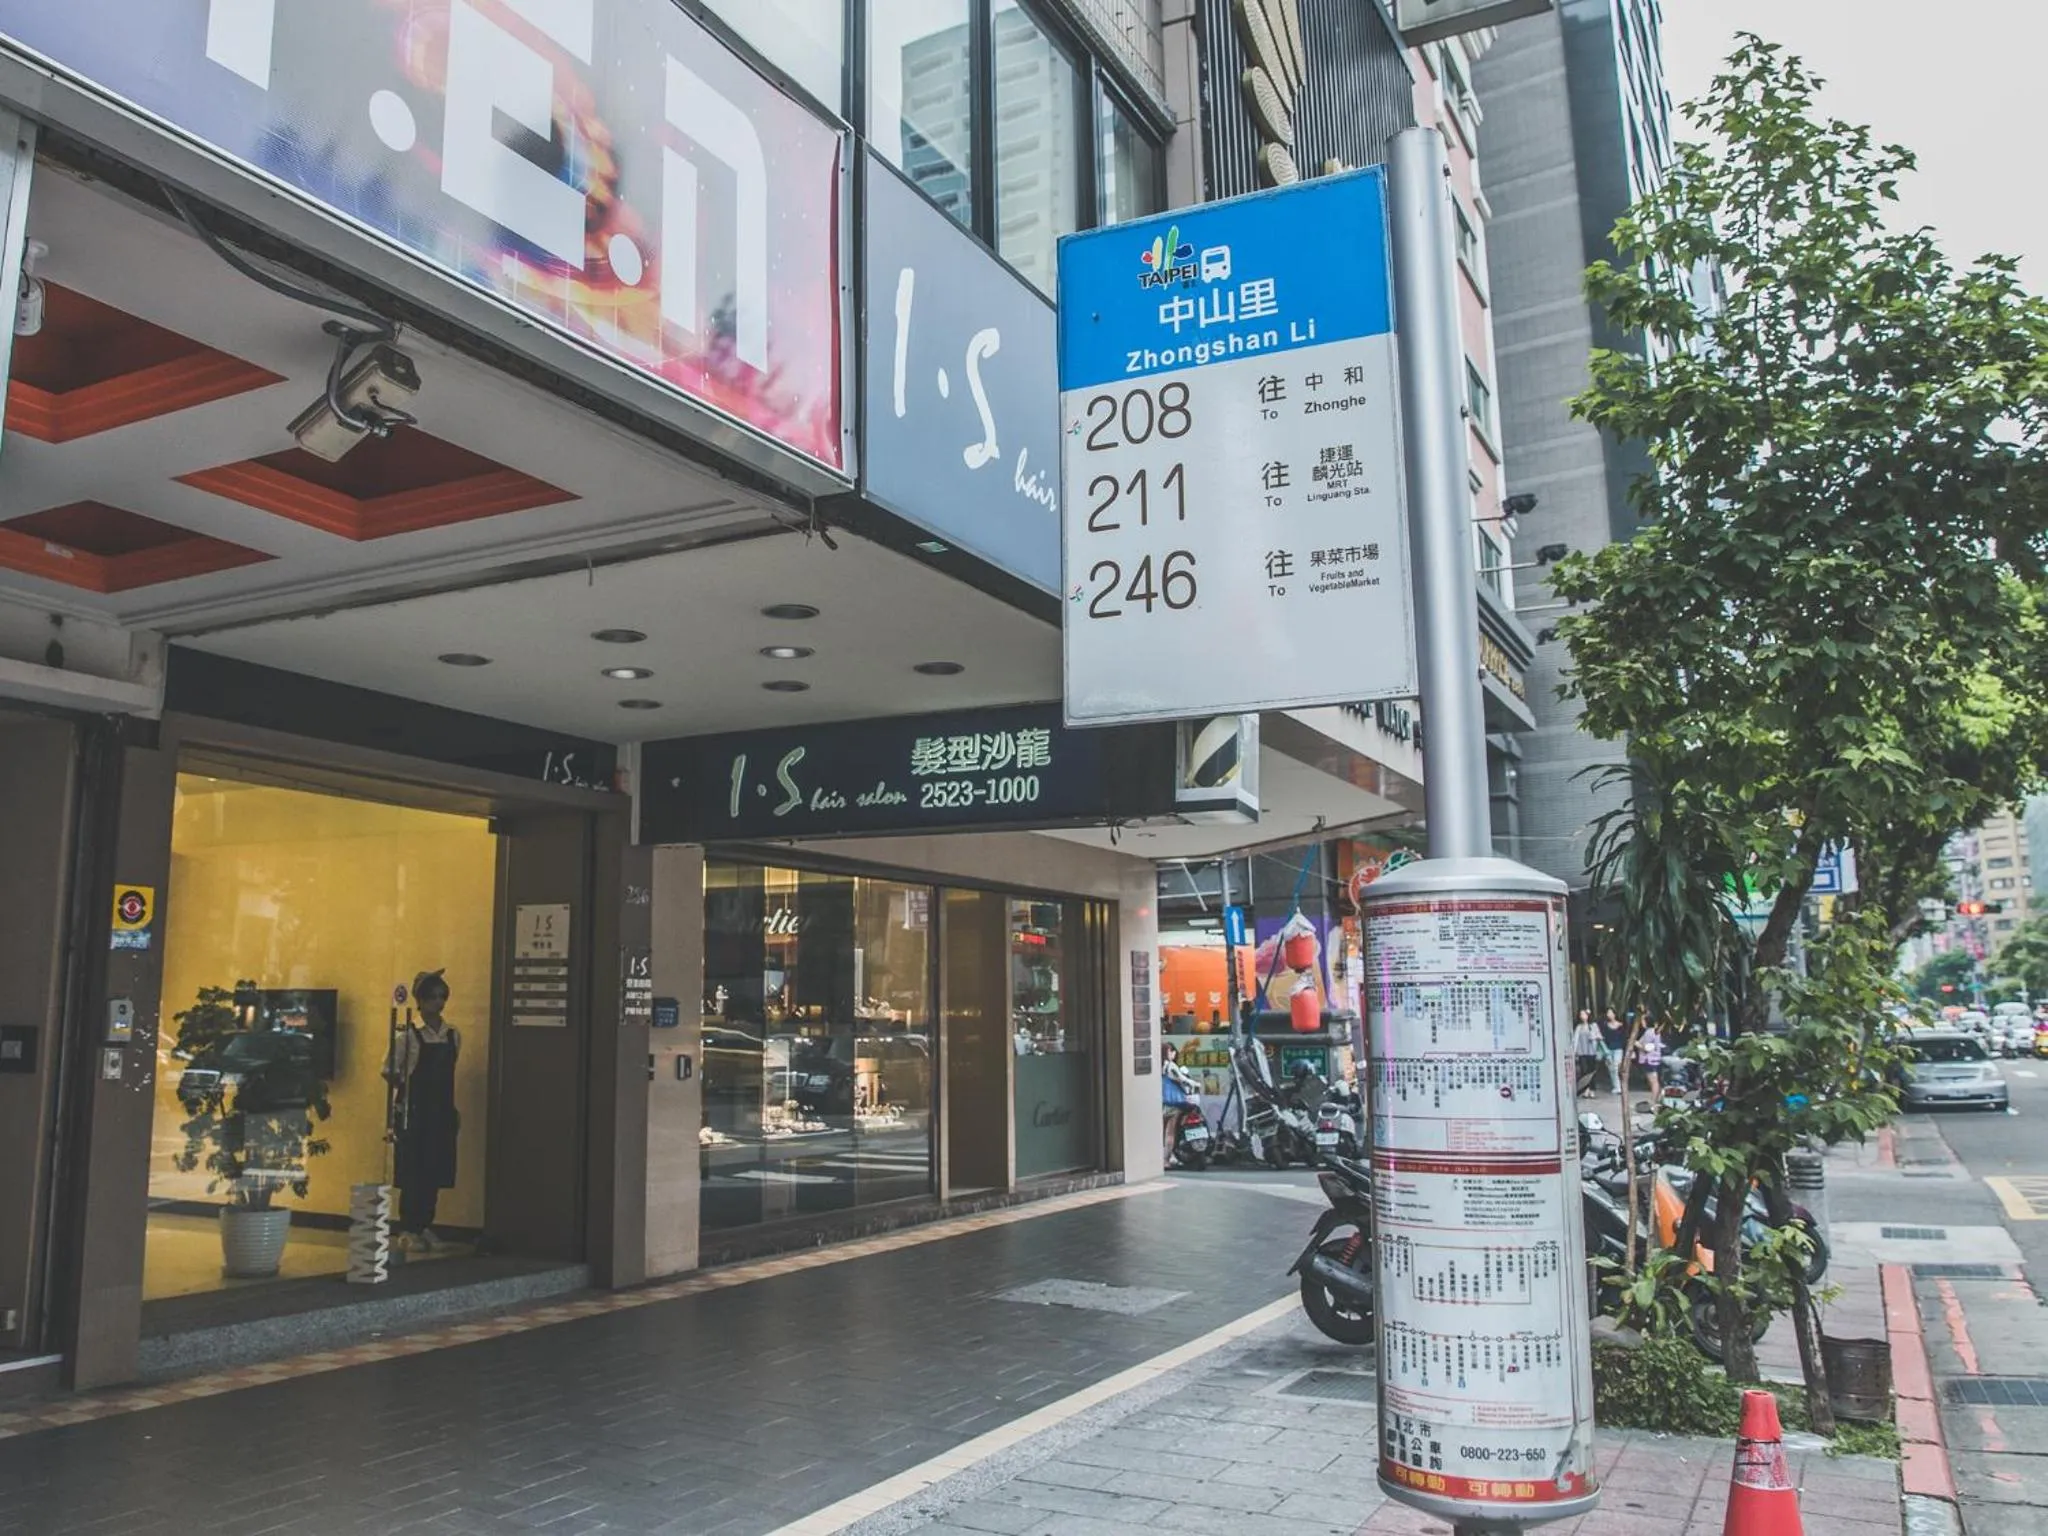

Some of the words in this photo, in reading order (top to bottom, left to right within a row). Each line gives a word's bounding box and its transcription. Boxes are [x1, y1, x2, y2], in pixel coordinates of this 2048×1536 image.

[1137, 262, 1199, 289] TAIPEI
[1159, 278, 1278, 333] 中山里
[1126, 329, 1278, 372] Zhongshan
[1290, 319, 1315, 342] Li
[1258, 375, 1287, 403] 往
[1086, 382, 1192, 451] 208
[1261, 408, 1279, 421] To
[1304, 396, 1366, 414] Zhonghe
[1015, 448, 1057, 512] hair
[1262, 461, 1290, 490] 往
[1320, 444, 1354, 463] 捷運
[1312, 460, 1363, 481] 麟光站
[1088, 463, 1185, 533] 211
[1264, 496, 1282, 508] To
[1307, 488, 1352, 502] Linguang
[1327, 479, 1348, 489] MRT
[1265, 550, 1294, 579] 往
[1310, 543, 1380, 568] 果菜市場
[1321, 570, 1346, 581] Fruits
[1348, 569, 1365, 578] and
[1089, 550, 1197, 619] 246
[1268, 585, 1286, 598] To
[911, 728, 1051, 775] 髮型沙龍
[810, 787, 846, 811] hair
[856, 781, 907, 807] salon
[920, 775, 1040, 808] 2523-1000
[1460, 1445, 1546, 1461] 0800-223-650
